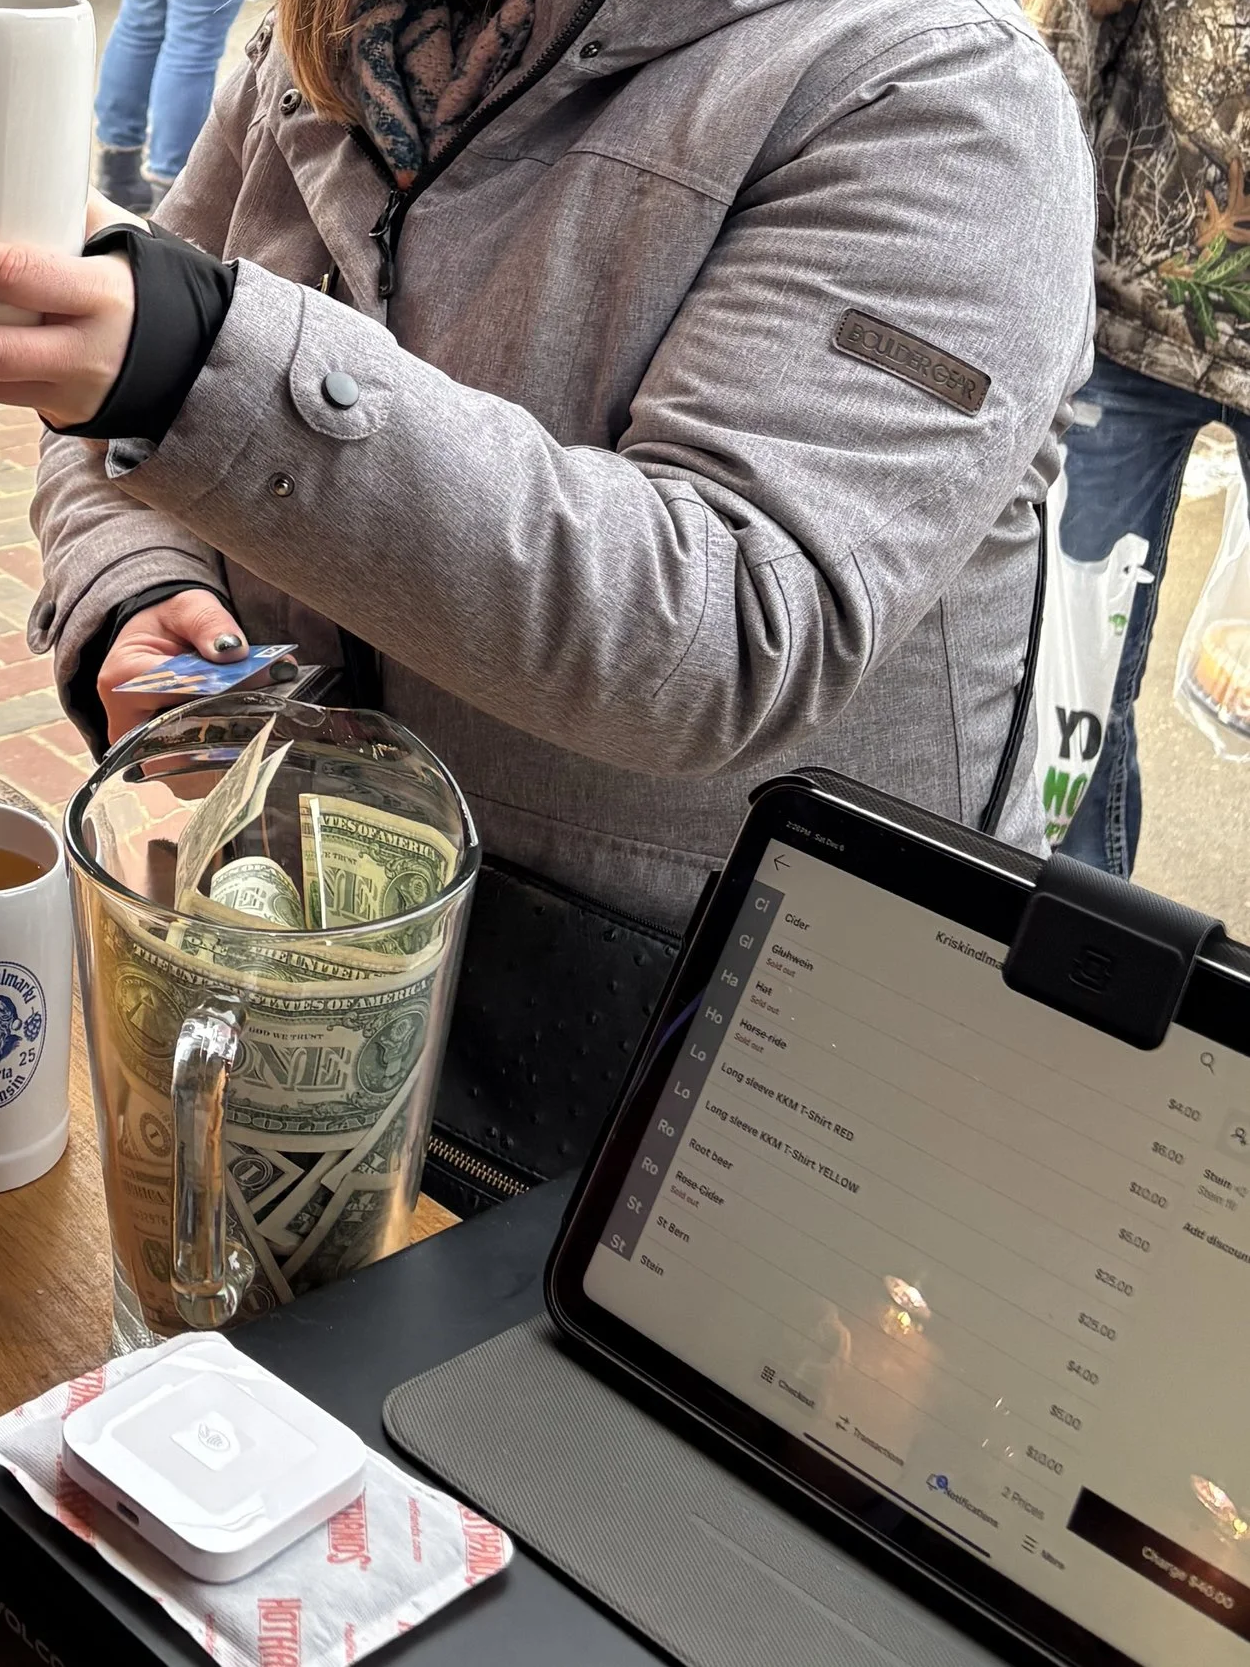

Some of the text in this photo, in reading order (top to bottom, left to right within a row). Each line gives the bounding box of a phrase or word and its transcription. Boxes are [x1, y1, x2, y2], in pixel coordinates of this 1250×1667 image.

[847, 323, 977, 402] BOULDER GEAR
[357, 823, 377, 838] OF
[377, 831, 437, 861] AMERICA
[332, 852, 358, 866] TRUST
[754, 896, 770, 914] Ci
[935, 930, 1005, 971] Kriskindlma
[720, 968, 740, 988] Ha
[765, 957, 797, 979] Sold out
[754, 979, 773, 997] Hat
[249, 993, 325, 1012] STATES
[326, 998, 352, 1011] OF
[750, 994, 781, 1016] Sold out
[704, 1005, 723, 1025] Ho
[784, 912, 1202, 1123] Cider $4.00
[273, 1031, 289, 1040] WE
[289, 1032, 324, 1041] TRUST
[733, 1032, 766, 1054] Sold out
[739, 1017, 767, 1042] Horse
[767, 1033, 788, 1051] ride
[19, 1047, 36, 1067] 25
[689, 1043, 707, 1062] Lo
[673, 1081, 691, 1100] Lo
[720, 1061, 746, 1085] Long
[746, 1075, 776, 1099] sleeve
[775, 1091, 800, 1113] KKM
[800, 1104, 834, 1131] T-Shirt
[833, 1123, 855, 1142] RED
[657, 1118, 675, 1138] Ro
[688, 1137, 712, 1159] Root
[711, 1150, 735, 1171] beer
[704, 1099, 729, 1122] Long
[729, 1114, 760, 1138] sleeve
[759, 1130, 784, 1152] KKM
[783, 1143, 818, 1171] T-Shirt
[817, 1162, 861, 1196] YELLOW
[641, 1155, 659, 1176] Ro
[669, 1184, 701, 1210] Sold out
[674, 1169, 699, 1191] Rose
[698, 1184, 726, 1207] Cider
[626, 1194, 644, 1215] St
[656, 1215, 669, 1230] St
[667, 1222, 690, 1244] Bern
[1182, 1221, 1207, 1240] Add
[609, 1233, 627, 1254] St
[639, 1253, 665, 1277] Stein
